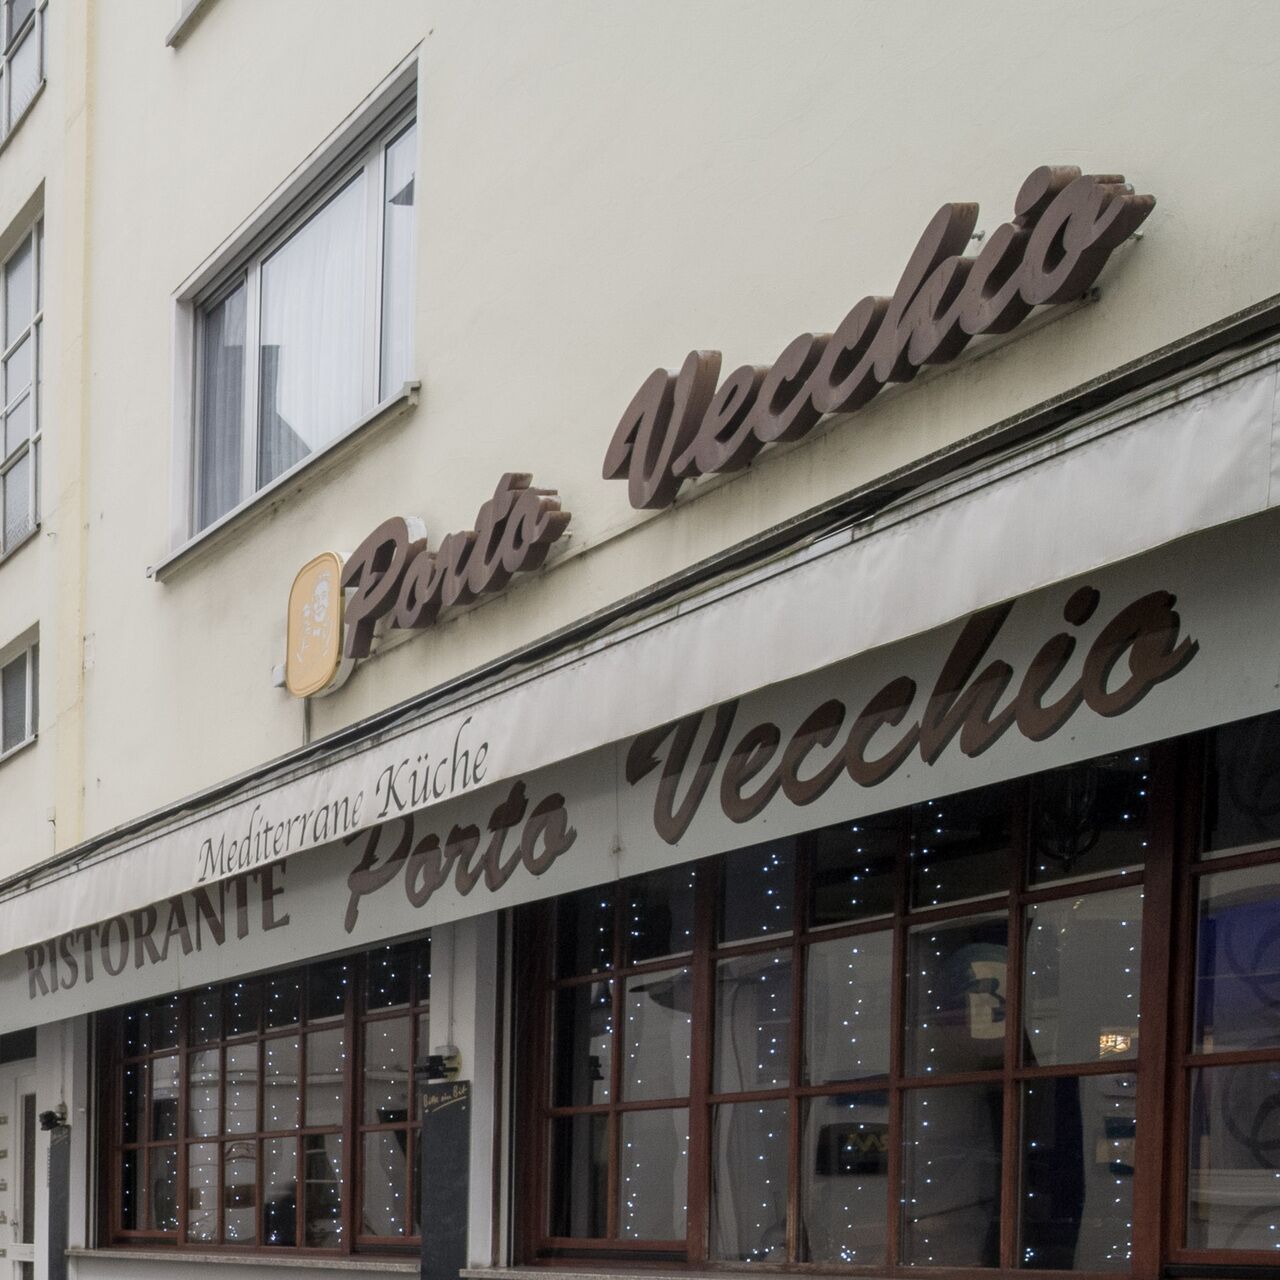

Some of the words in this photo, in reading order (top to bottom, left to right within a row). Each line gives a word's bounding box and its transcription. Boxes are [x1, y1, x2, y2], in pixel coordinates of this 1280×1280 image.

[343, 473, 570, 659] Porto
[603, 165, 1156, 509] Vecchio
[25, 862, 291, 1001] RISTORANTE
[344, 780, 579, 934] Porto
[626, 586, 1199, 845] Vecchio
[197, 790, 365, 884] Mediterrane
[377, 717, 489, 818] Küche
